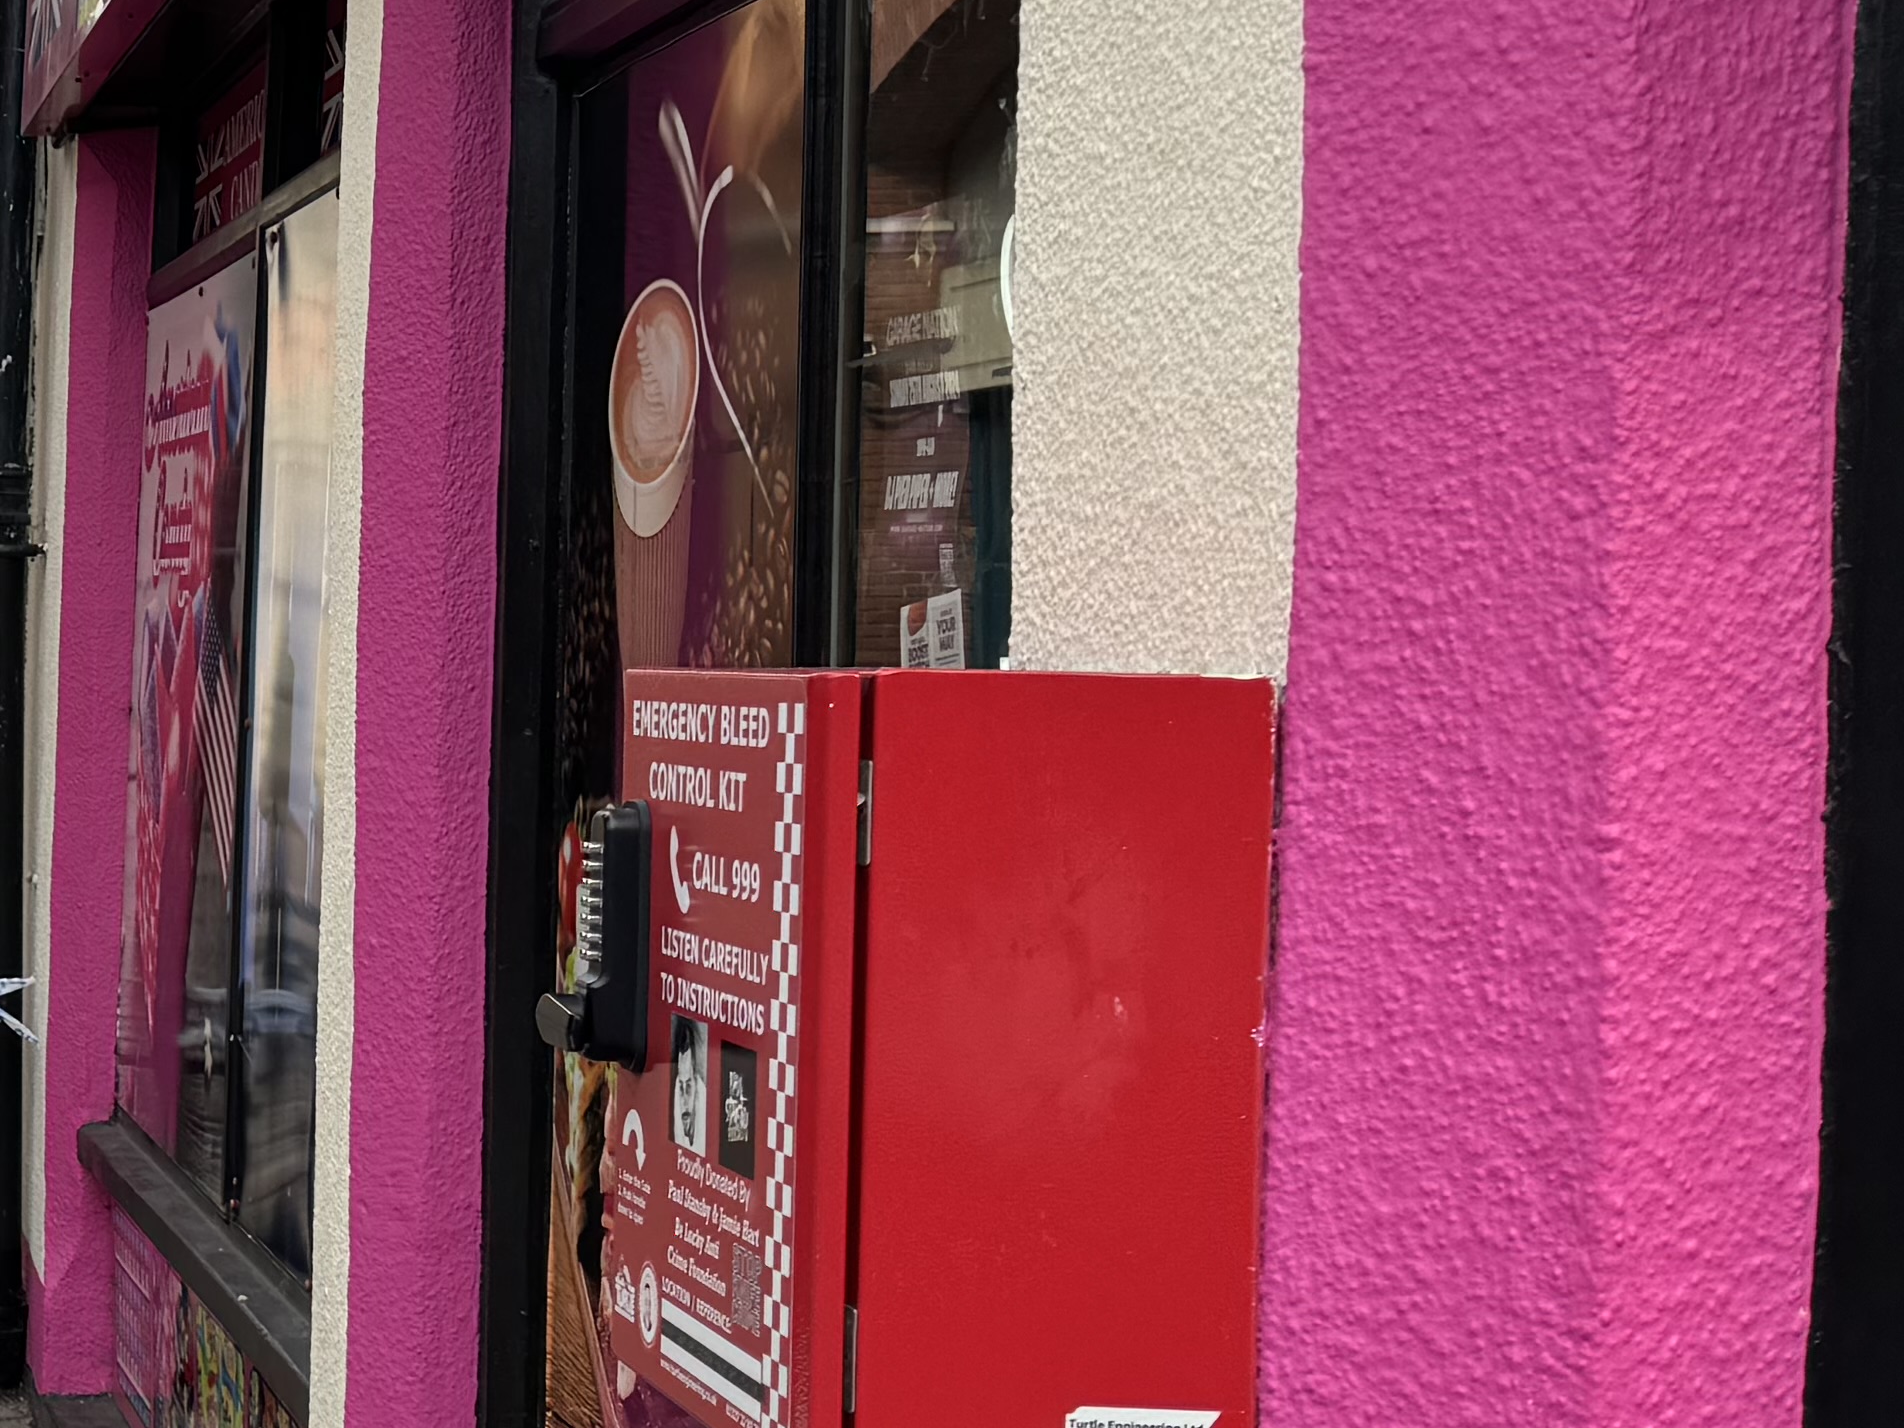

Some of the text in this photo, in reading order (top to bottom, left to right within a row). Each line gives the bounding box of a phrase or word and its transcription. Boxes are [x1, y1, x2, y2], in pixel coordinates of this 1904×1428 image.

[633, 700, 770, 748] EMERGENCY BLEED
[649, 761, 747, 812] CONTROL KIT
[692, 852, 760, 903] CALL 999
[661, 926, 769, 985] LISTEN CAREFULLY
[661, 972, 765, 1036] TO INSTRUCTIONS
